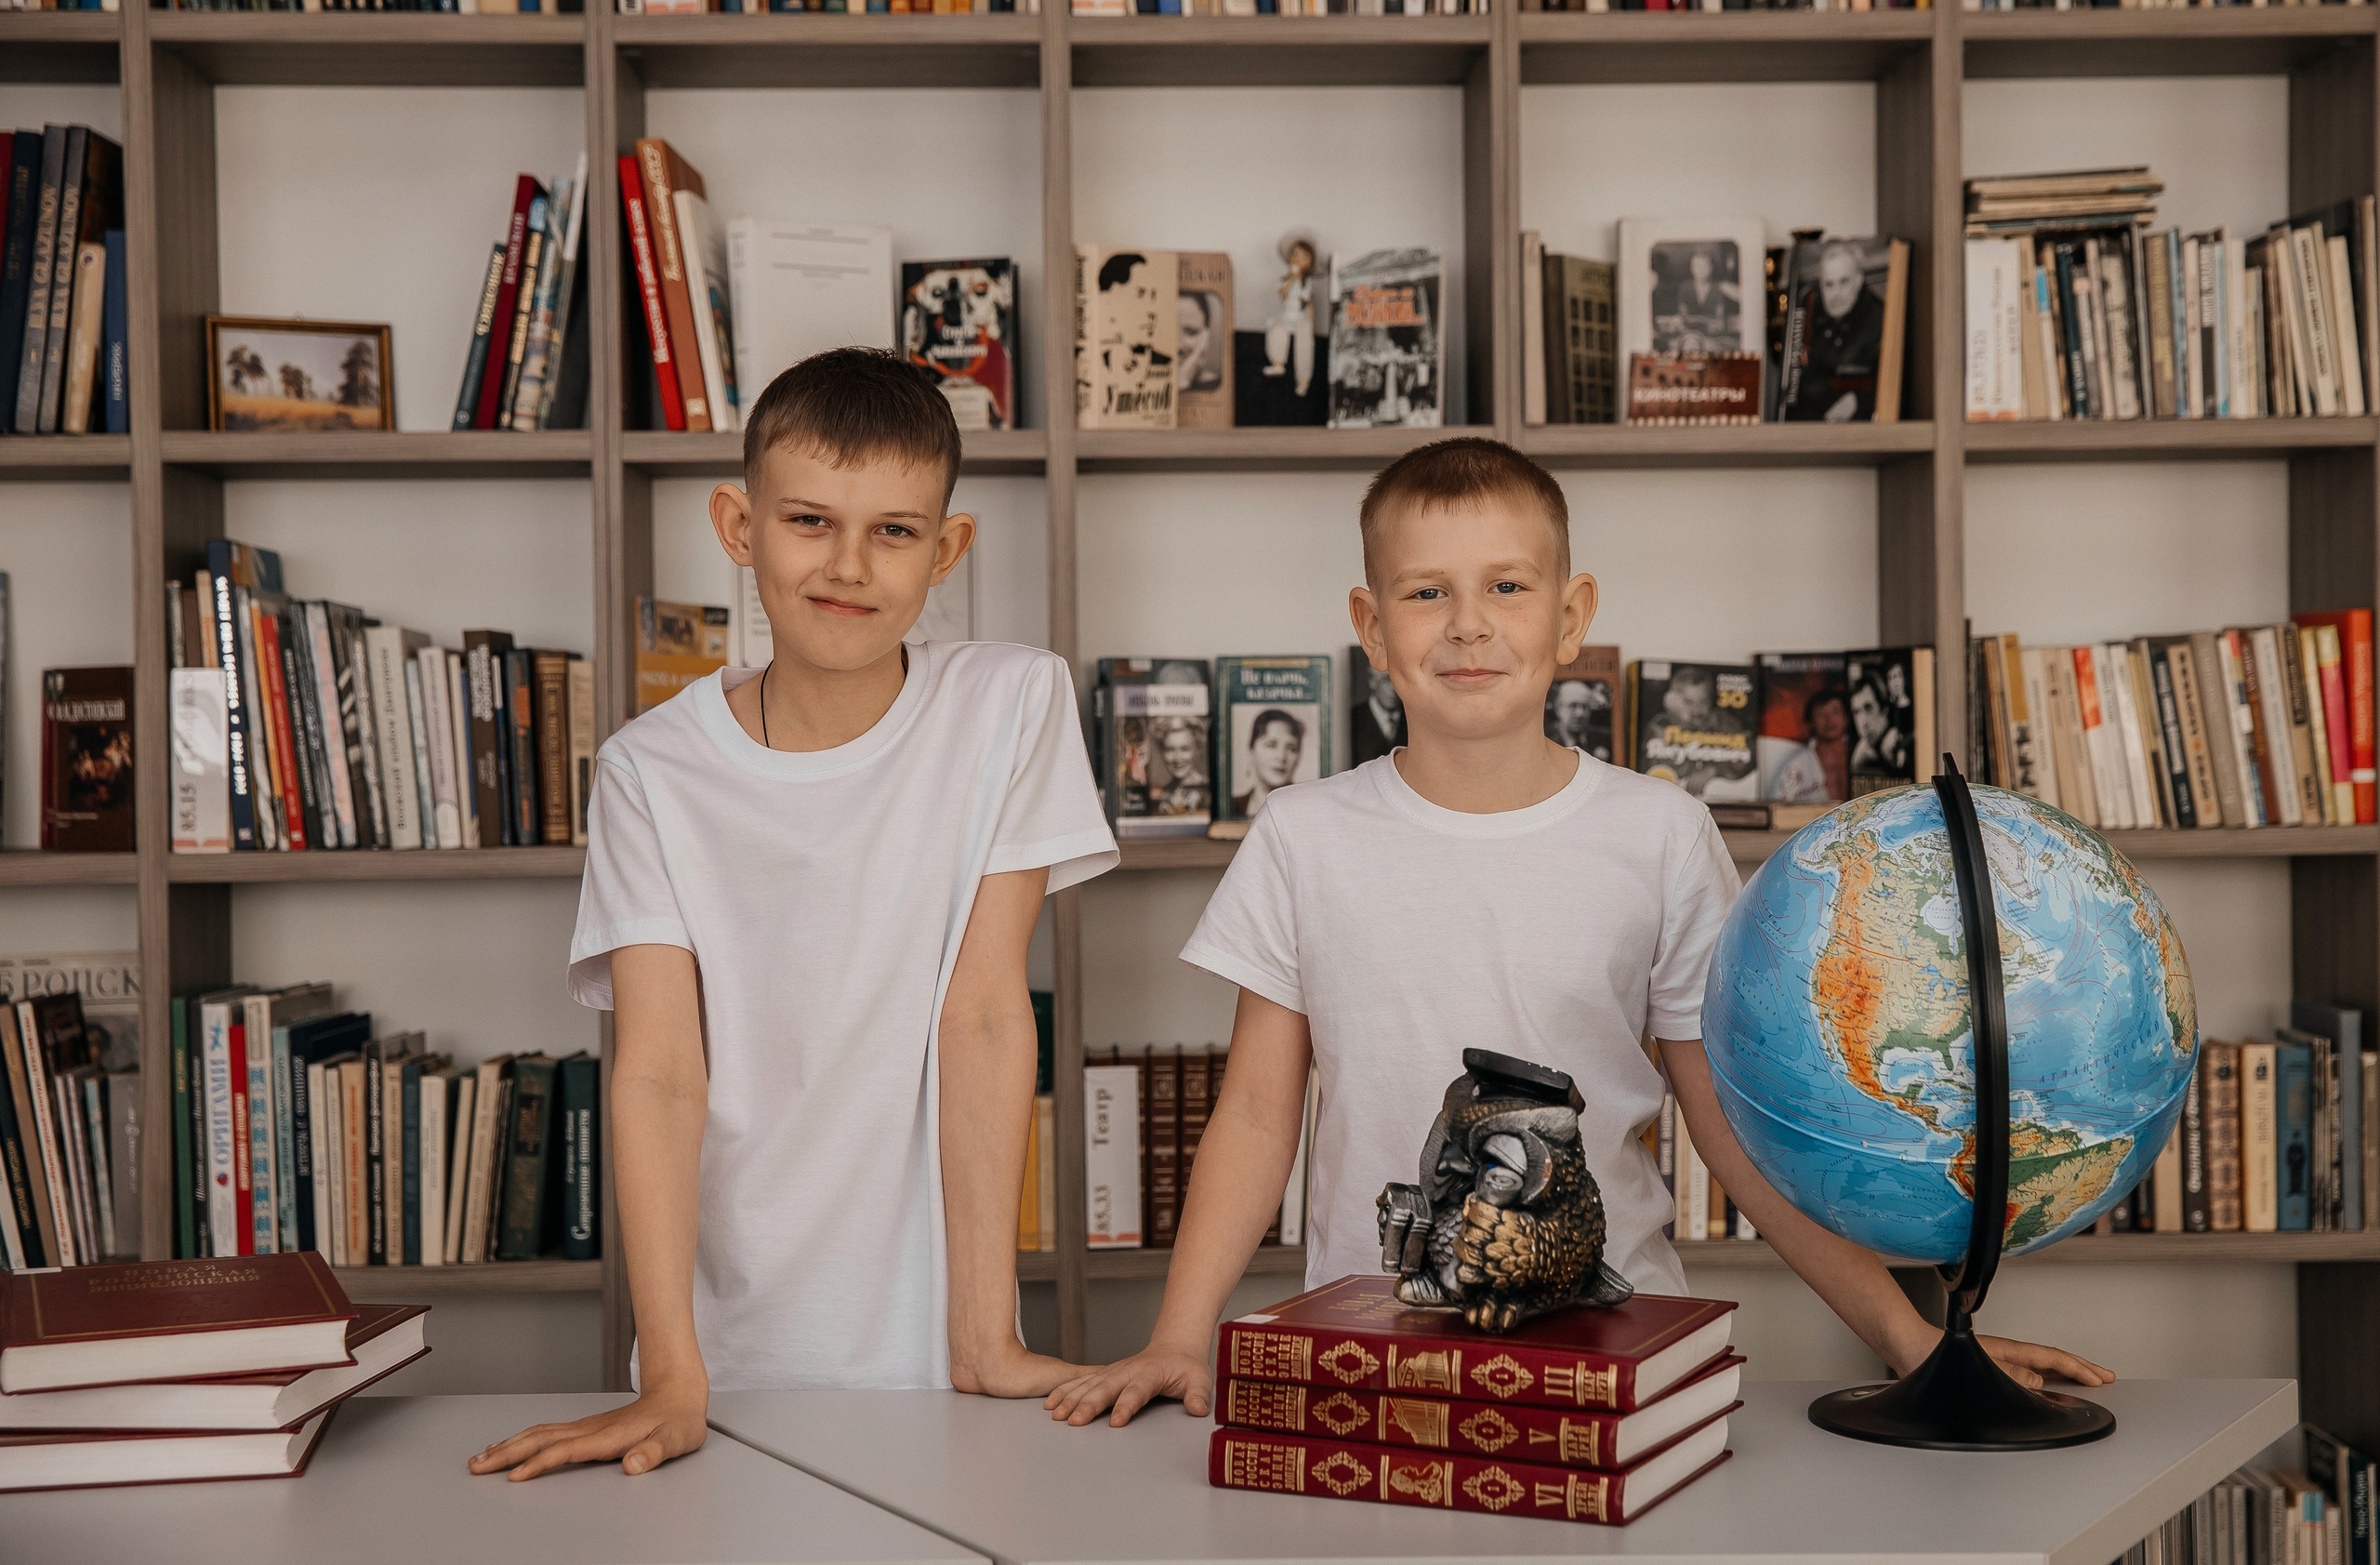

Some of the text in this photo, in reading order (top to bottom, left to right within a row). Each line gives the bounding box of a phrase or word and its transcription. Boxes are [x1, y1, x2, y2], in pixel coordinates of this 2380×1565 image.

[1633, 386, 1747, 405] КИНОТЕАТРЫ
[1717, 691, 1748, 709] 30
[2039, 1021, 2160, 1084] АТЛАНТИЧЕСКИЙ
[209, 1058, 231, 1165] ОРИГАМИ
[1092, 1088, 1115, 1147] Театр
[1093, 1184, 1113, 1233] 85.33
[88, 1268, 257, 1285] РОССИЙСКАЯ
[89, 1275, 260, 1293] ЭНЦИКЛОПЕДИЯ
[125, 1265, 217, 1277] НОВАЯ
[1239, 1332, 1252, 1374] НОВАЯ
[1252, 1333, 1266, 1376] РОССИЙ
[1265, 1333, 1279, 1377] СКАЯ
[1278, 1334, 1291, 1378] ЭНЦИК
[1236, 1381, 1249, 1424] НОВАЯ
[1544, 1365, 1574, 1398] III
[1249, 1382, 1262, 1425] РОССИЙ
[1261, 1384, 1274, 1426] СКАЯ
[1273, 1385, 1286, 1428] ЭНЦИК
[1528, 1427, 1556, 1446] V
[1234, 1441, 1246, 1485] НОВАЯ
[1246, 1442, 1259, 1487] РОССИЙ
[1260, 1444, 1272, 1488] СКАЯ
[1272, 1445, 1284, 1489] ЭНЦИК
[1535, 1481, 1565, 1507] VI
